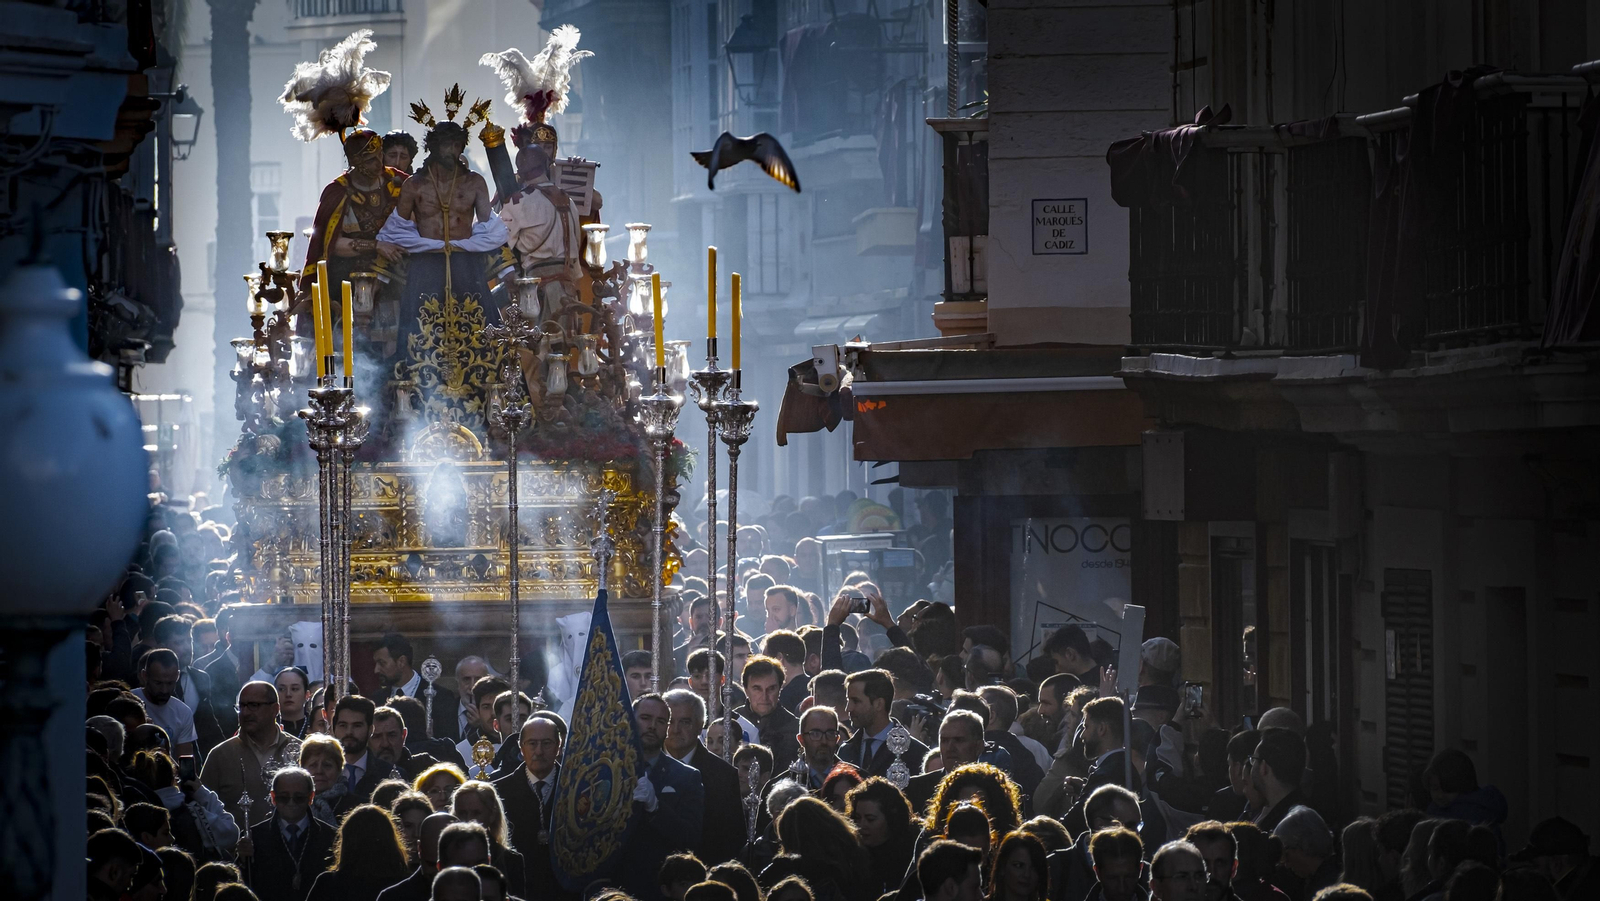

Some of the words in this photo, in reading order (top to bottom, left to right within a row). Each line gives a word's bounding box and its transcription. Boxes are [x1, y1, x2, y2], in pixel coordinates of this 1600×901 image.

[1043, 205, 1075, 213] CALLE
[1035, 214, 1083, 226] MARQUÉS
[1052, 228, 1066, 238] DE
[1044, 238, 1075, 249] CÁDIZ
[1081, 559, 1113, 569] desde
